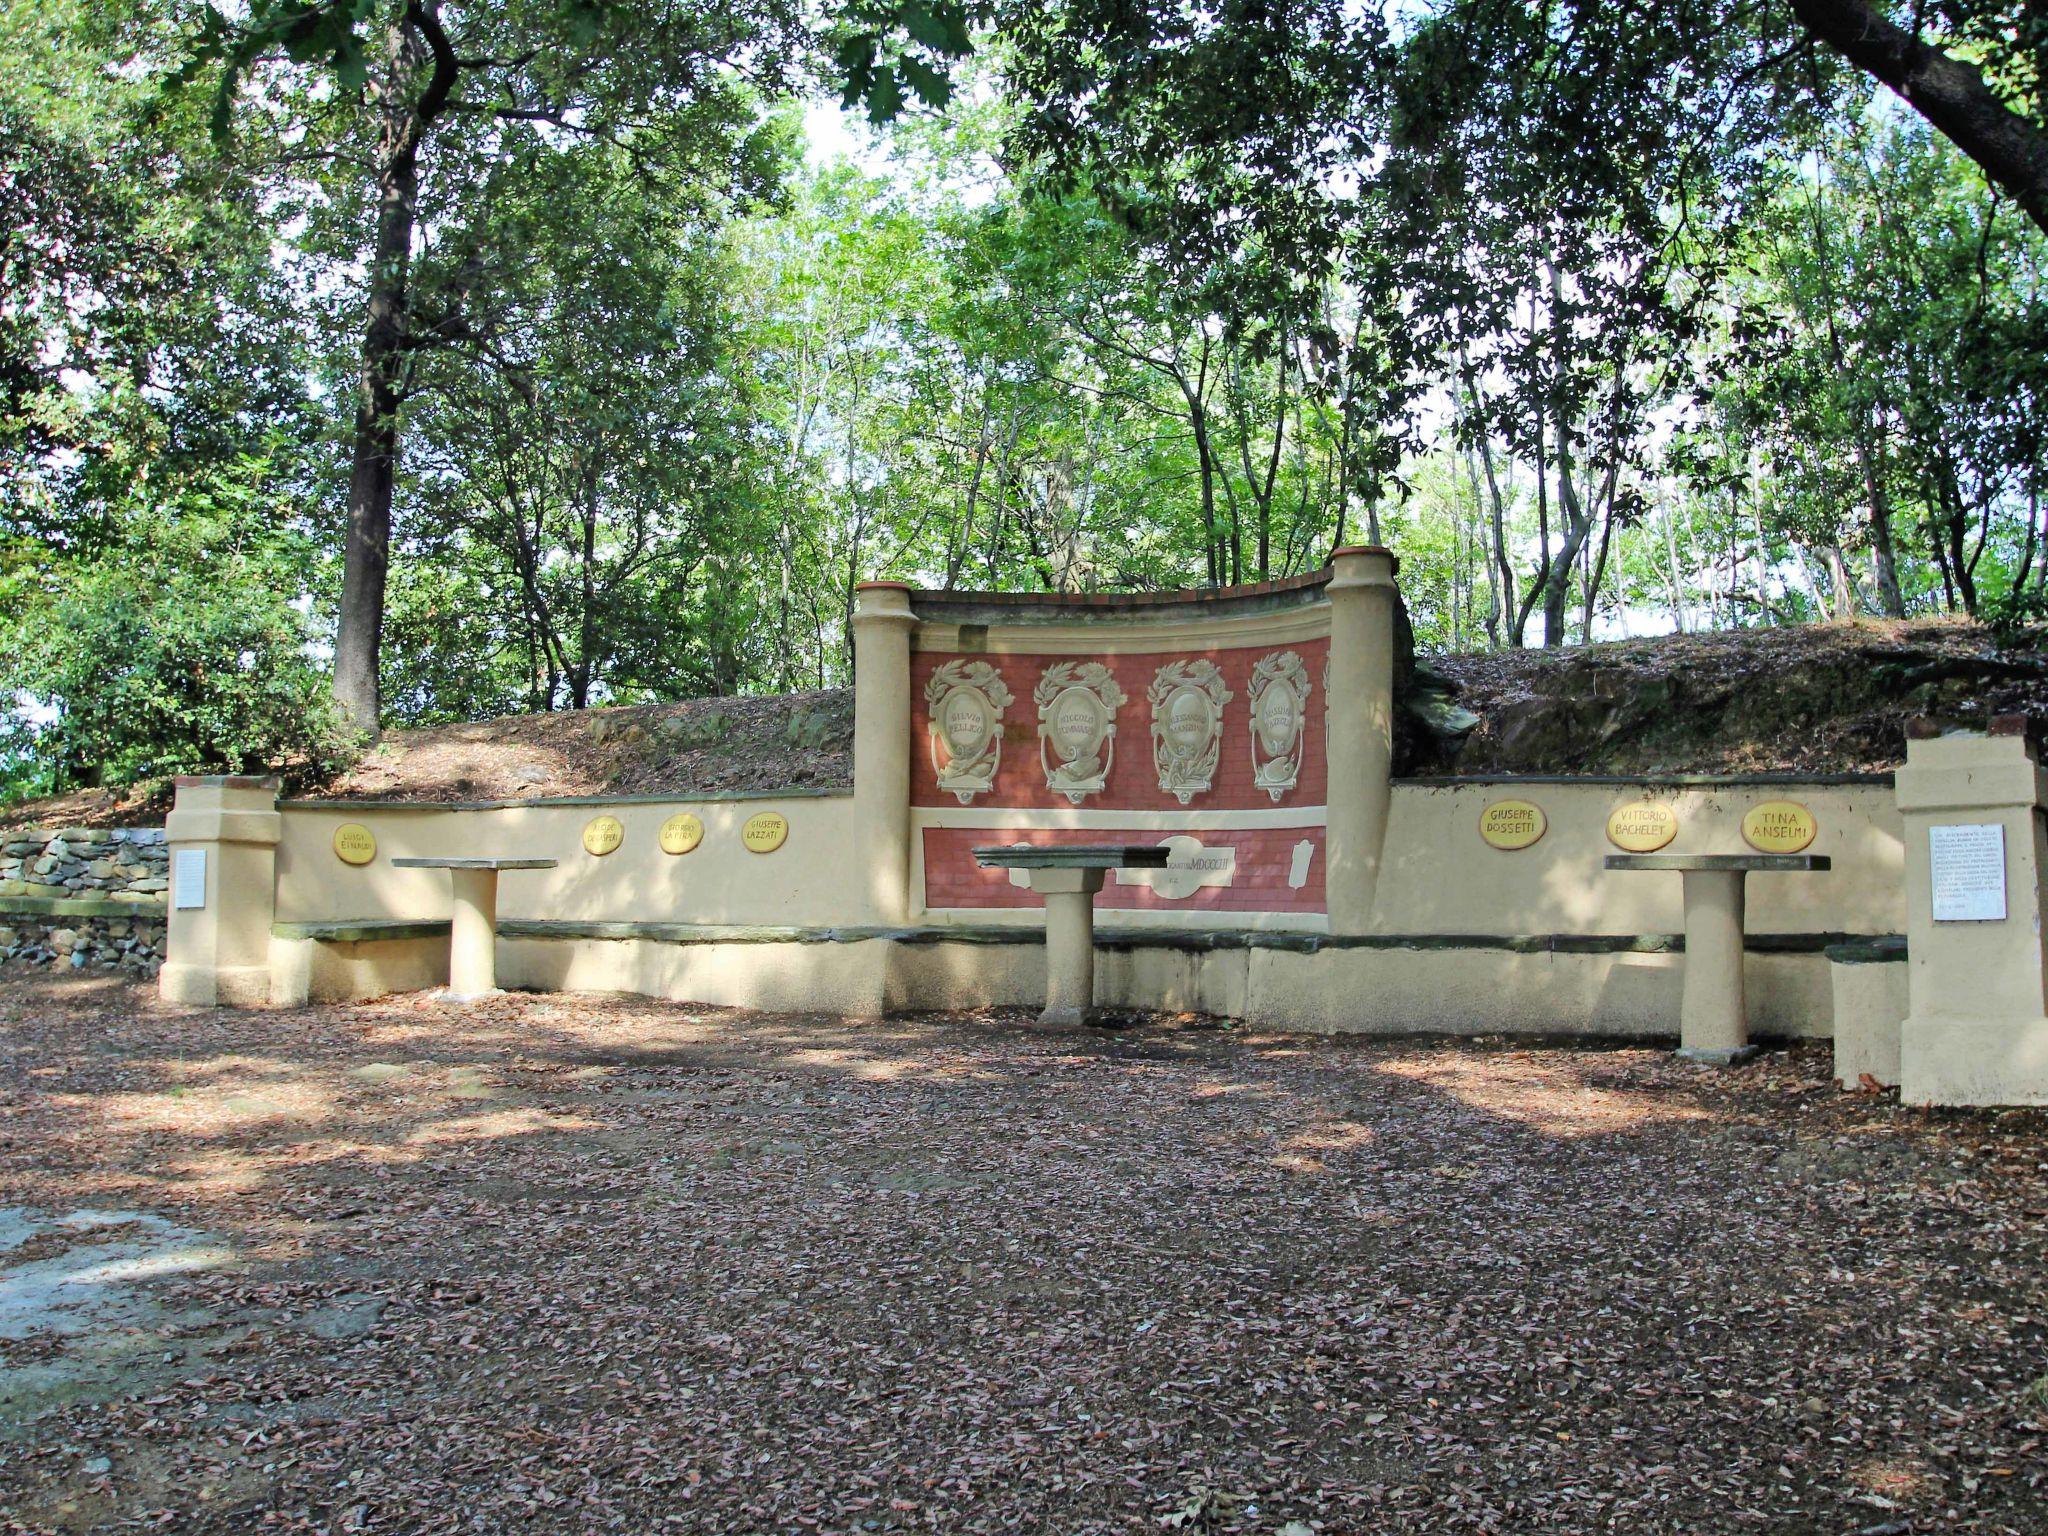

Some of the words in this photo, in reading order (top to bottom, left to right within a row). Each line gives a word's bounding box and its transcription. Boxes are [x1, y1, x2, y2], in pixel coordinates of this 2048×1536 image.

[1490, 809, 1534, 820] GIUSEPPE
[1621, 810, 1667, 821] VITTORIO
[1760, 813, 1799, 825] TINA
[1486, 822, 1535, 833] DOSSETTI
[1615, 823, 1666, 835] BACHELET
[1752, 825, 1807, 839] ANSELMI
[746, 830, 778, 839] LAZZATI
